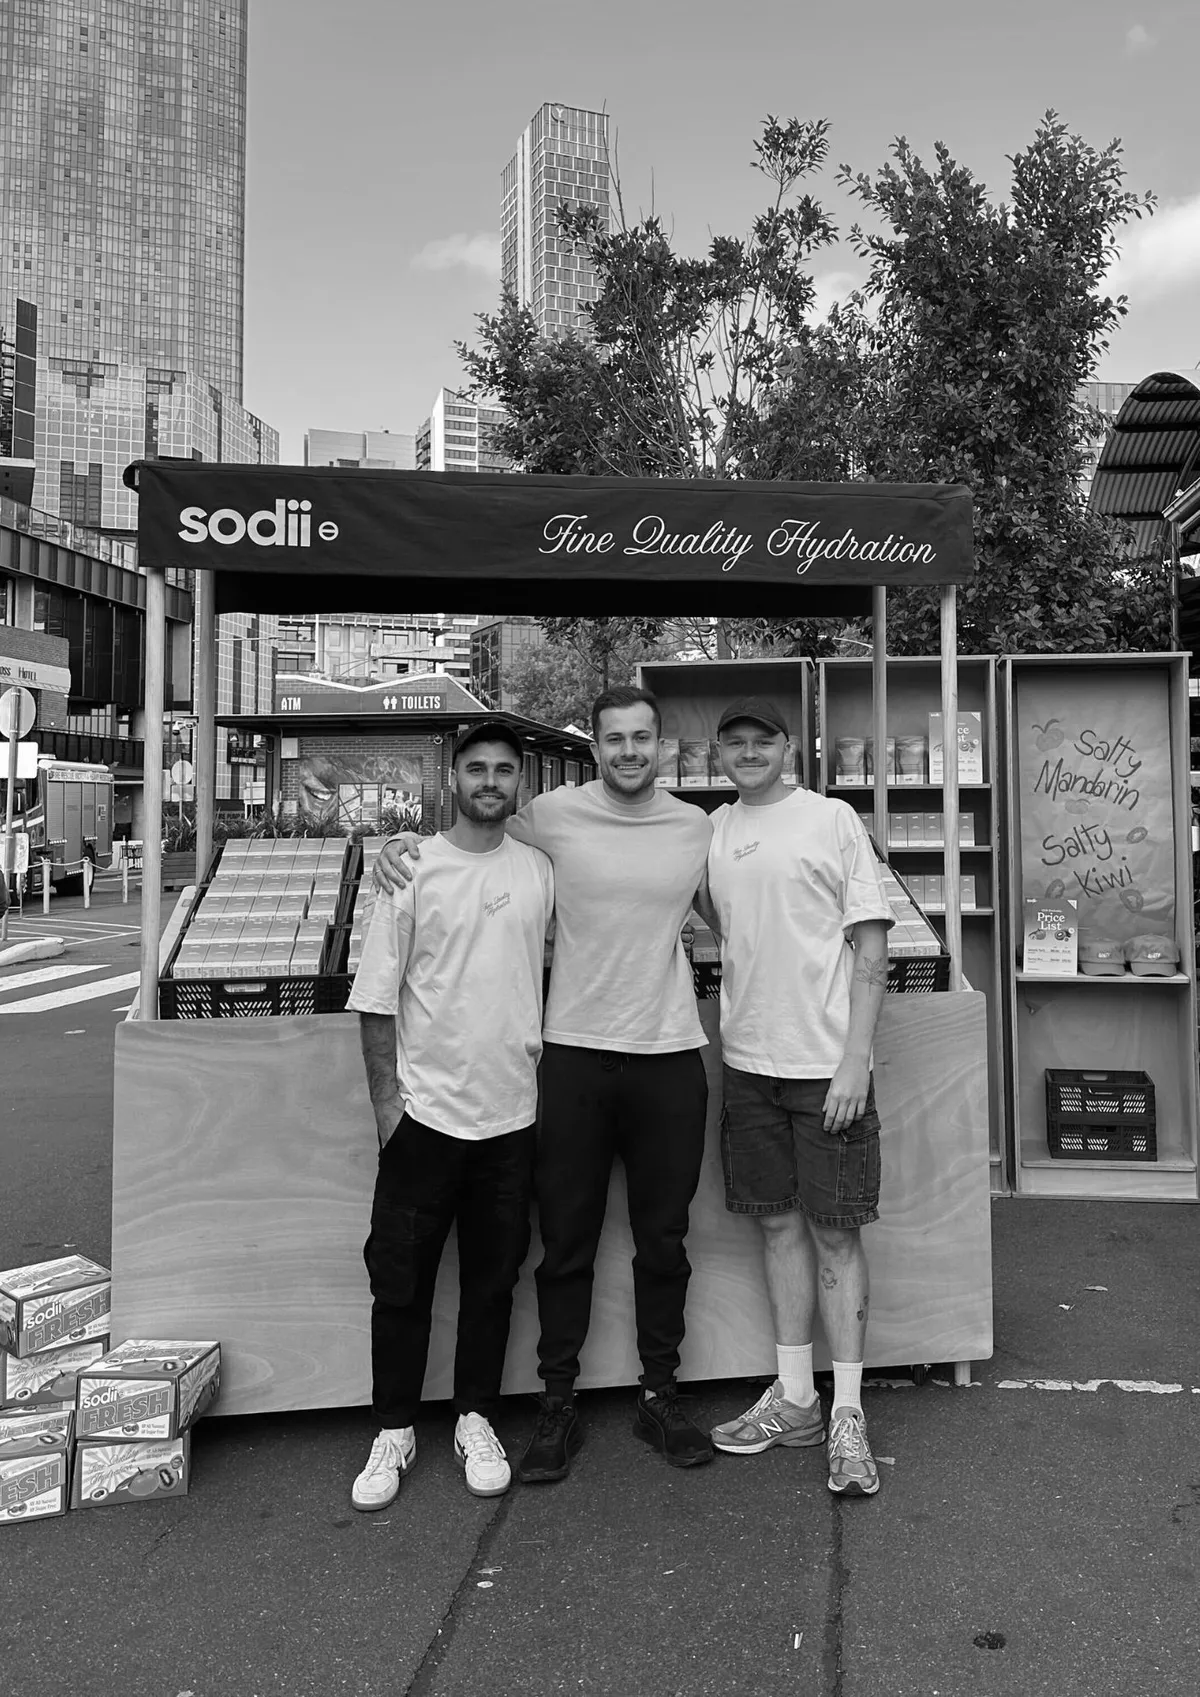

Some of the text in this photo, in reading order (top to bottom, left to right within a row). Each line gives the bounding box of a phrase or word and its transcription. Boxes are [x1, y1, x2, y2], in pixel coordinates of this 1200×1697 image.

[177, 498, 312, 547] sodii
[538, 513, 937, 575] Fine Quality Hydration
[281, 697, 301, 711] ATM
[401, 695, 441, 710] TOILETS
[1074, 729, 1142, 778] Salty
[1034, 757, 1140, 811] Mandarin
[1041, 824, 1114, 866] Salty
[1073, 856, 1133, 898] Kiwi
[1037, 911, 1065, 922] Price
[1040, 921, 1062, 931] List
[26, 1300, 62, 1330] sodii
[27, 1286, 111, 1352] FRESH
[82, 1389, 170, 1432] FRESH
[83, 1386, 118, 1408] sodii
[759, 1418, 784, 1438] N
